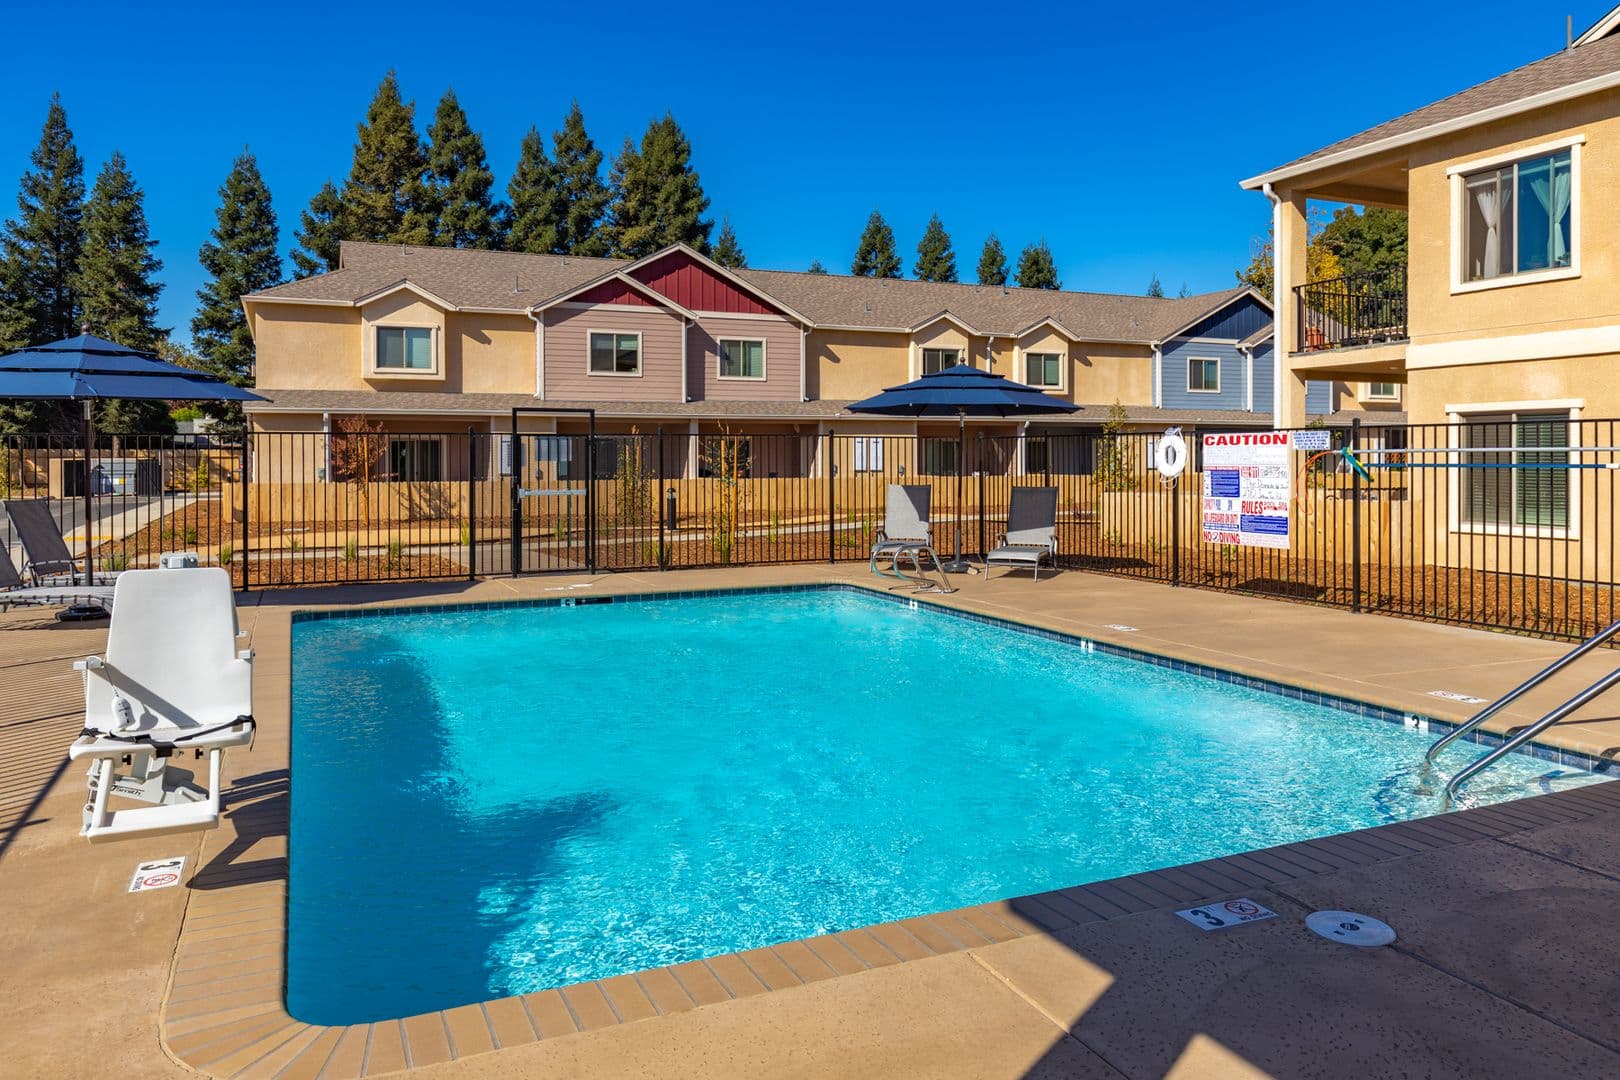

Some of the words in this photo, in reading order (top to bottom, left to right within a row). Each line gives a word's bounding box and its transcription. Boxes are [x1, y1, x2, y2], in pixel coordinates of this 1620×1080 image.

[1204, 434, 1288, 446] CAUTION
[1241, 500, 1264, 514] RULES
[1203, 531, 1212, 542] NO
[1219, 532, 1240, 545] DIVING
[140, 861, 181, 871] 3
[1190, 909, 1225, 926] 3
